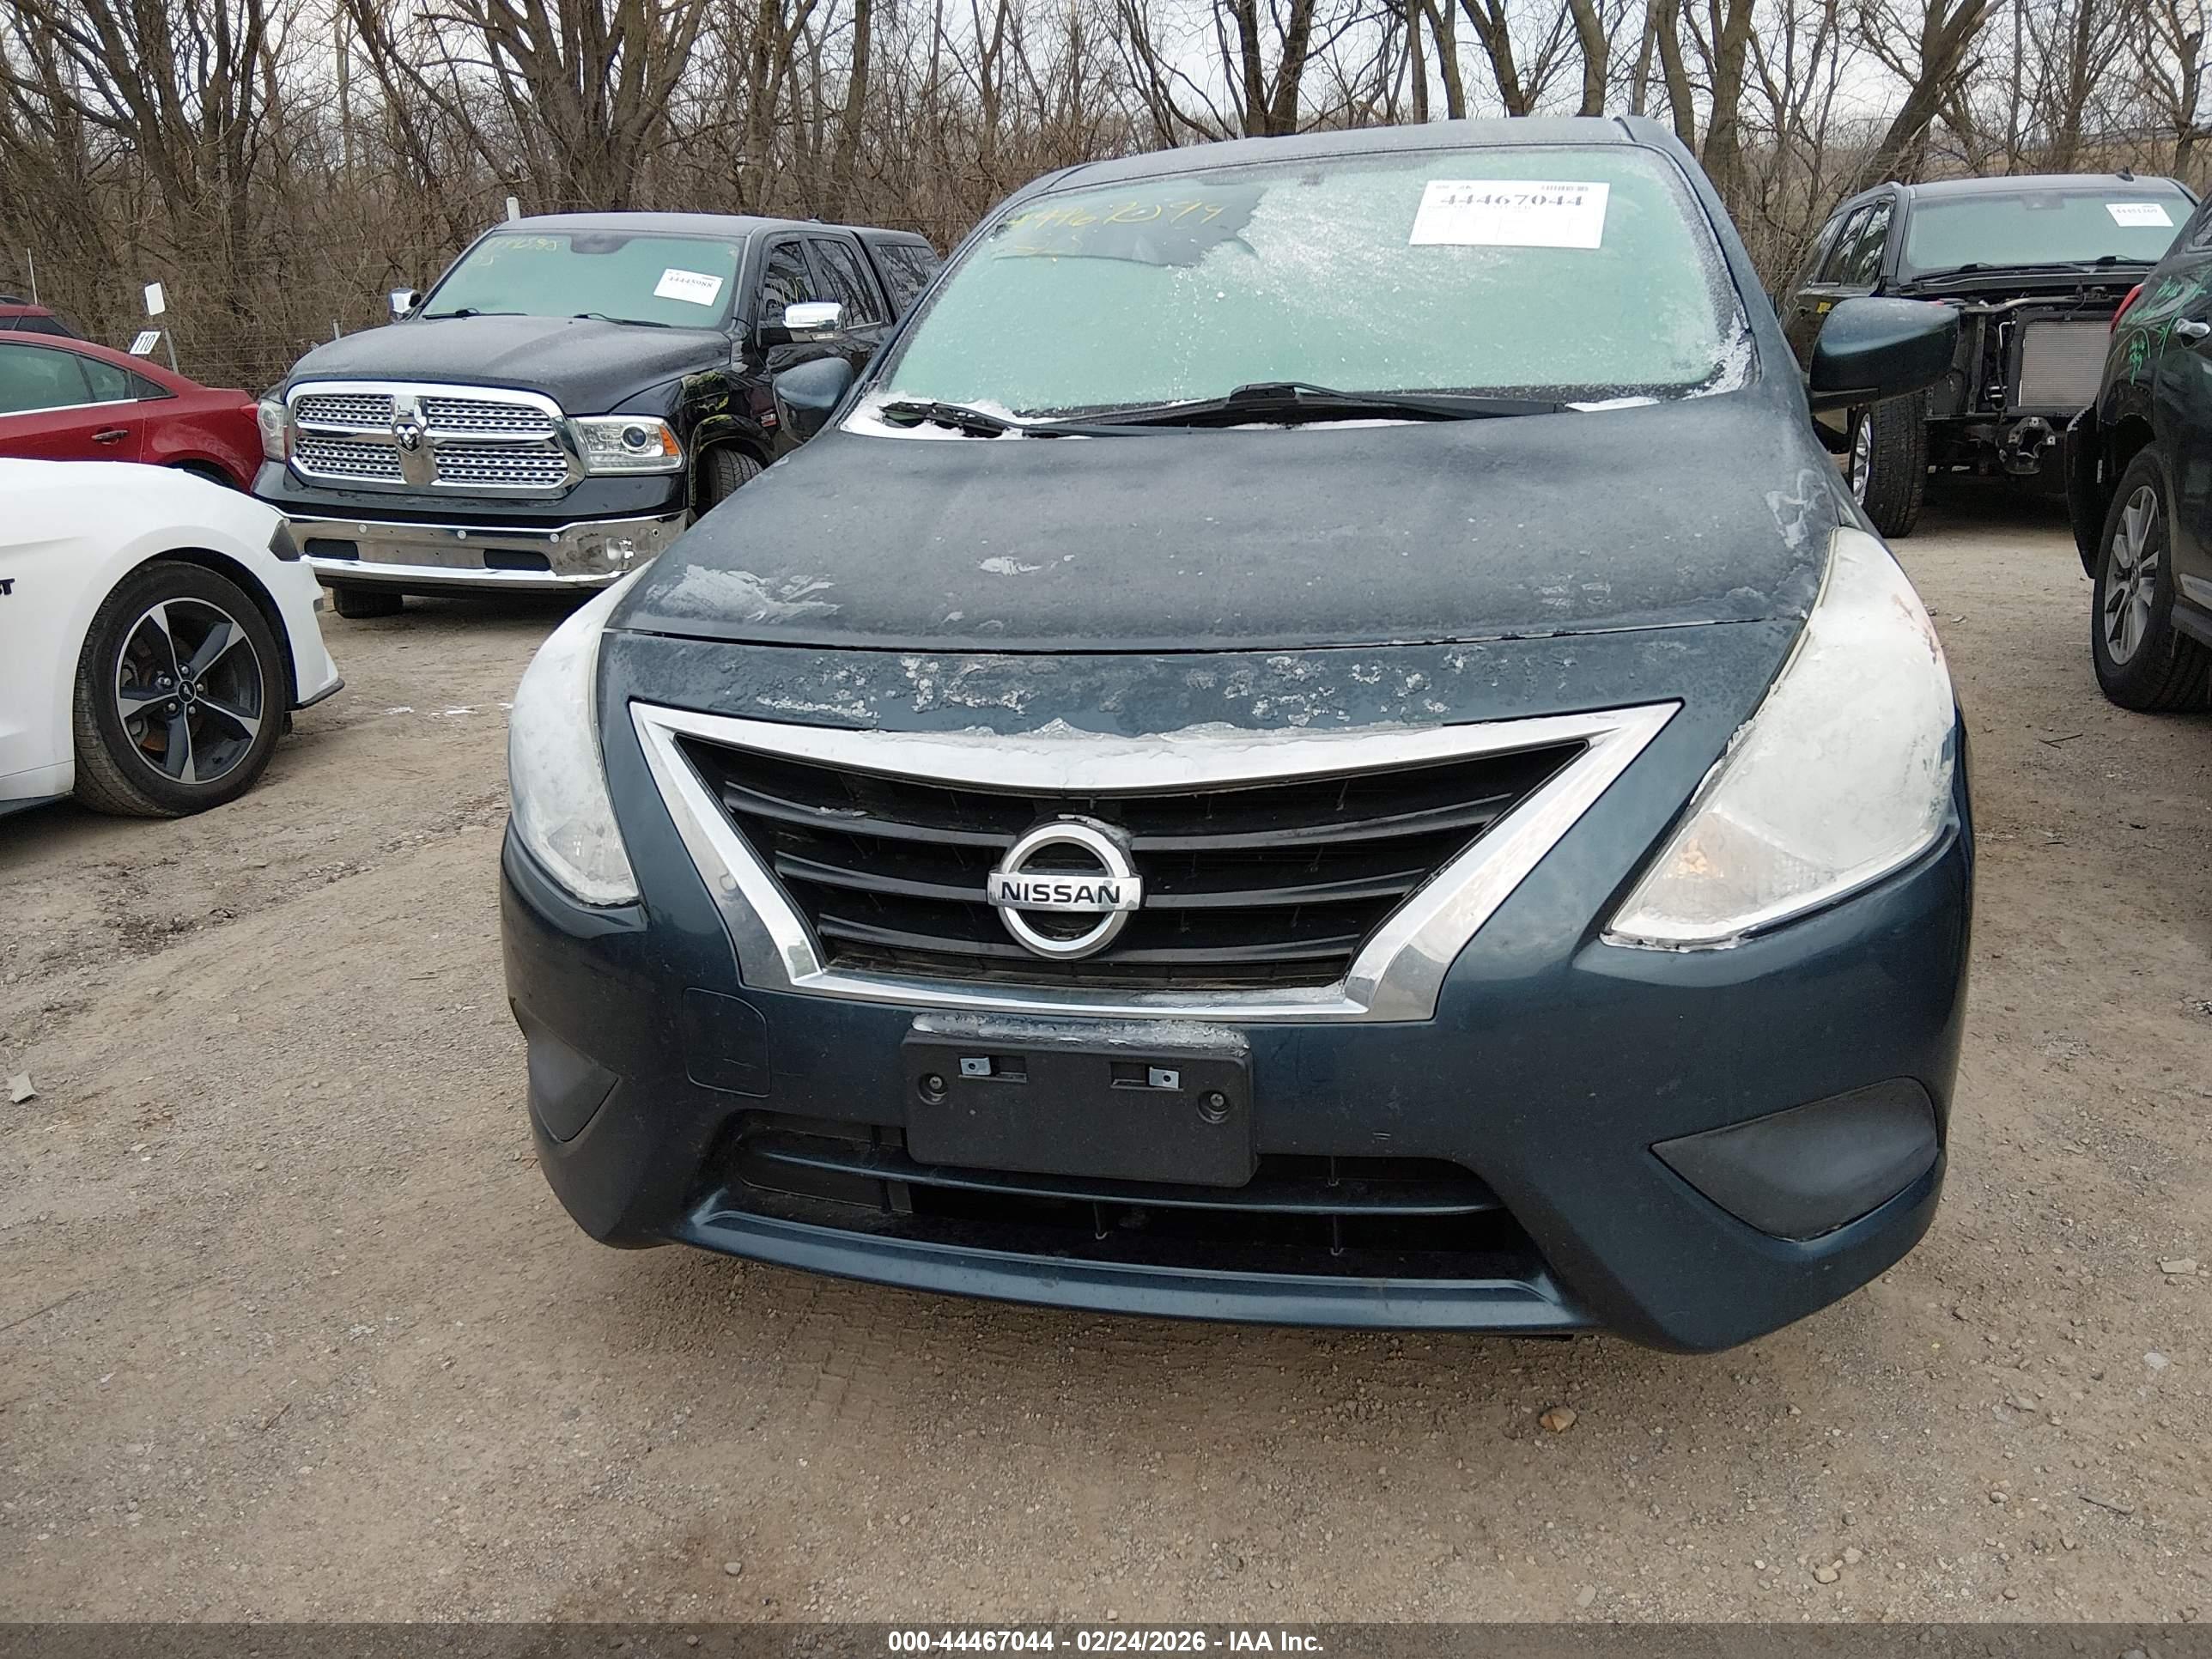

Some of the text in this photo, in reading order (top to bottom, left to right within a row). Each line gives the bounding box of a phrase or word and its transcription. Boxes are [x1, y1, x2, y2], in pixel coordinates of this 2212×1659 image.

[1440, 193, 1584, 207] 44467044
[134, 333, 156, 352] 110
[1001, 881, 1121, 904] NISSAN
